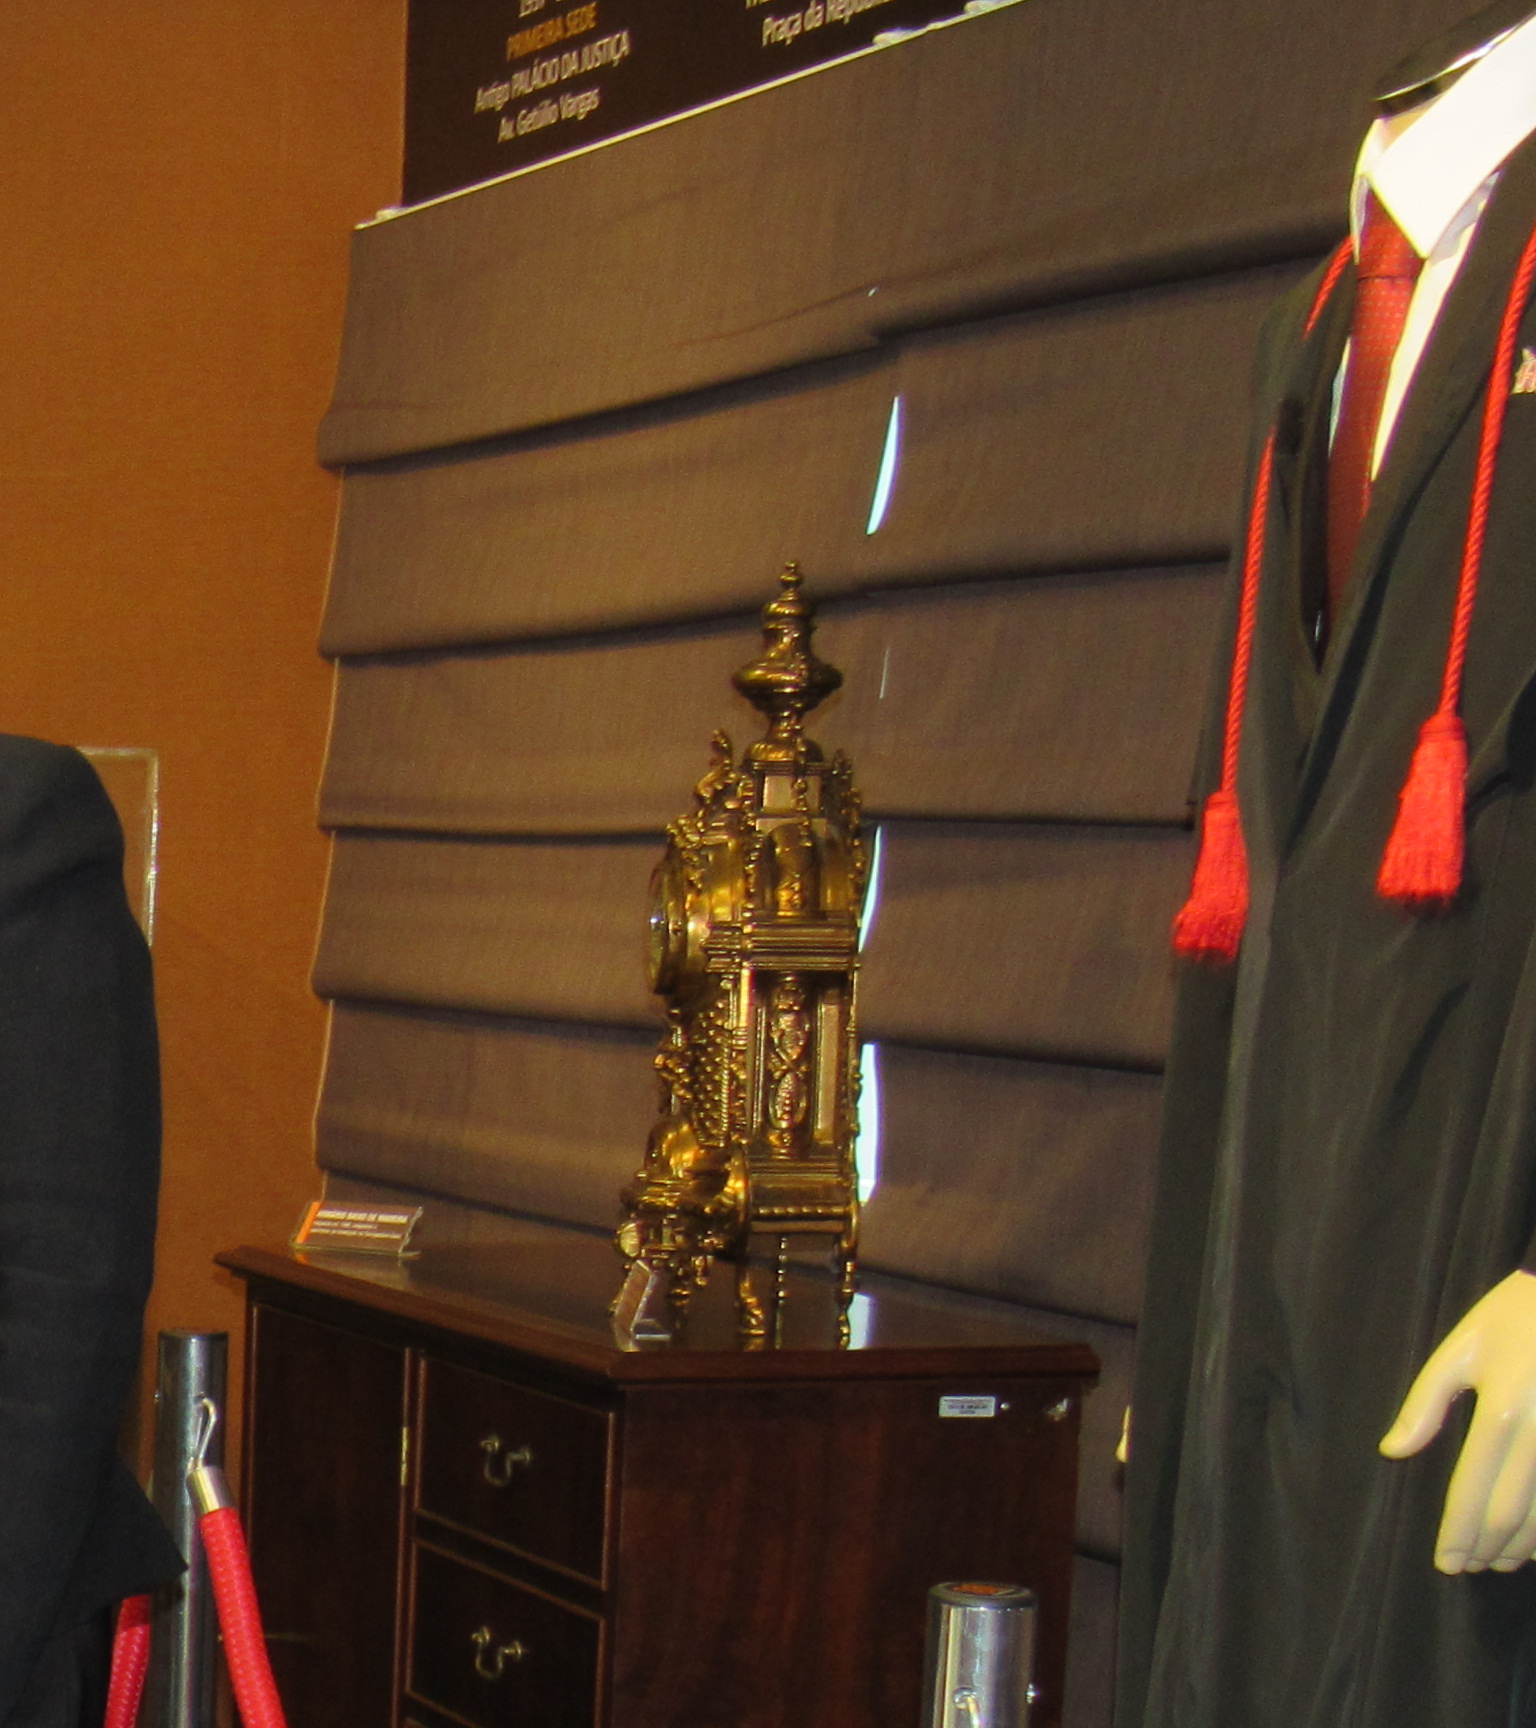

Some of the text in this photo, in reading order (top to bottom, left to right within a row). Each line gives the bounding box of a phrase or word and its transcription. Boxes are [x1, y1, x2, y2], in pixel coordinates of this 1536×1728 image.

[762, 11, 803, 47] Praça
[803, 0, 825, 31] da
[510, 57, 560, 100] PALÁCIO
[560, 50, 579, 81] DA
[579, 29, 630, 74] JUSTIÇA
